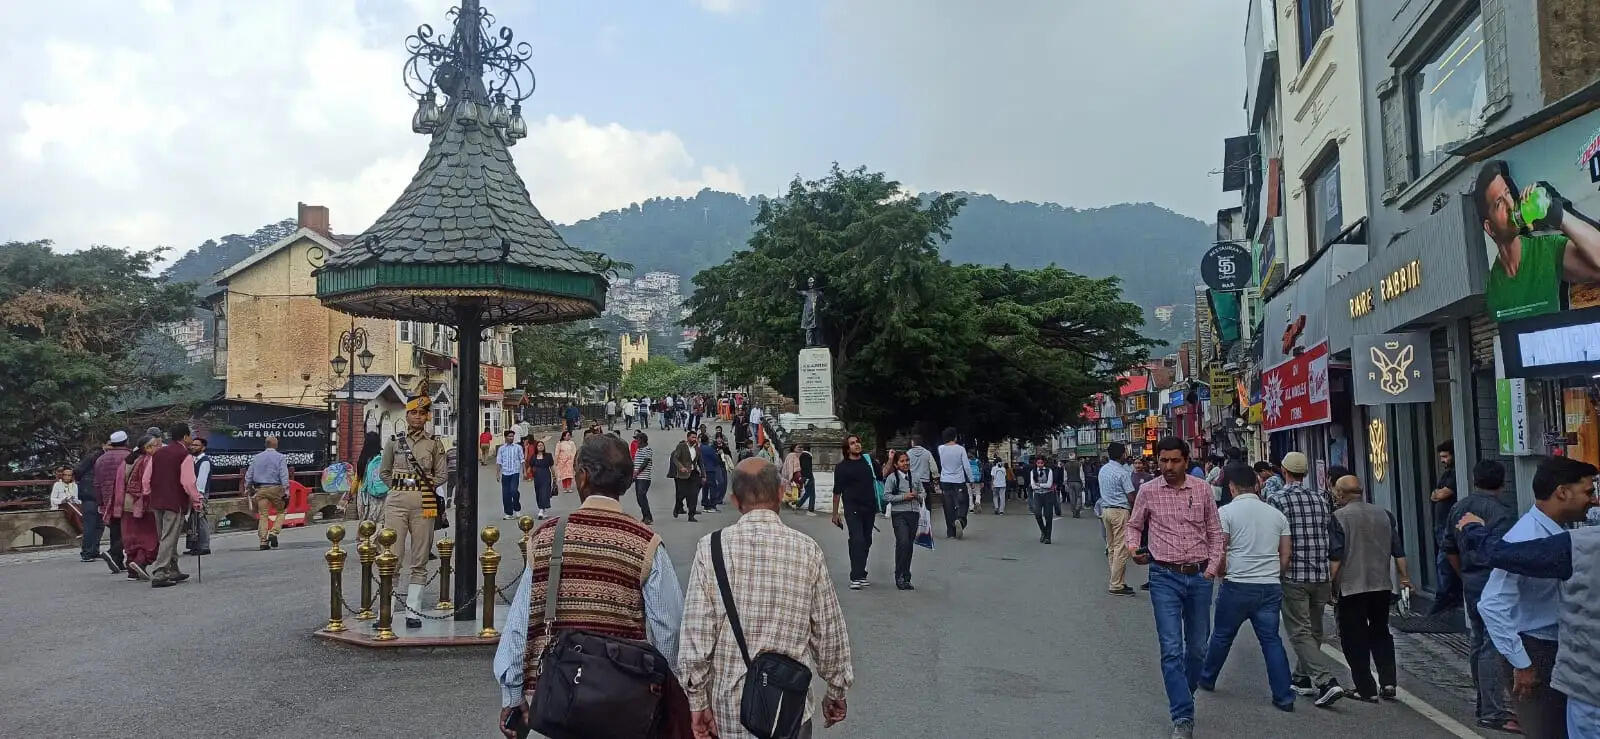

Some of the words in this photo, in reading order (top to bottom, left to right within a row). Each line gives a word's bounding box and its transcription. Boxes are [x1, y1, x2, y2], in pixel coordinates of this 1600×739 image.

[1209, 245, 1243, 257] RESTAURANT
[1349, 288, 1374, 319] RARE
[1380, 260, 1421, 303] RABBIT
[1413, 370, 1420, 378] R
[1515, 380, 1523, 414] Bank
[231, 430, 254, 438] CAFE
[255, 430, 262, 438] &
[263, 430, 281, 438] BAR
[283, 430, 318, 438] LOUNGE
[1517, 418, 1525, 451] J&K
